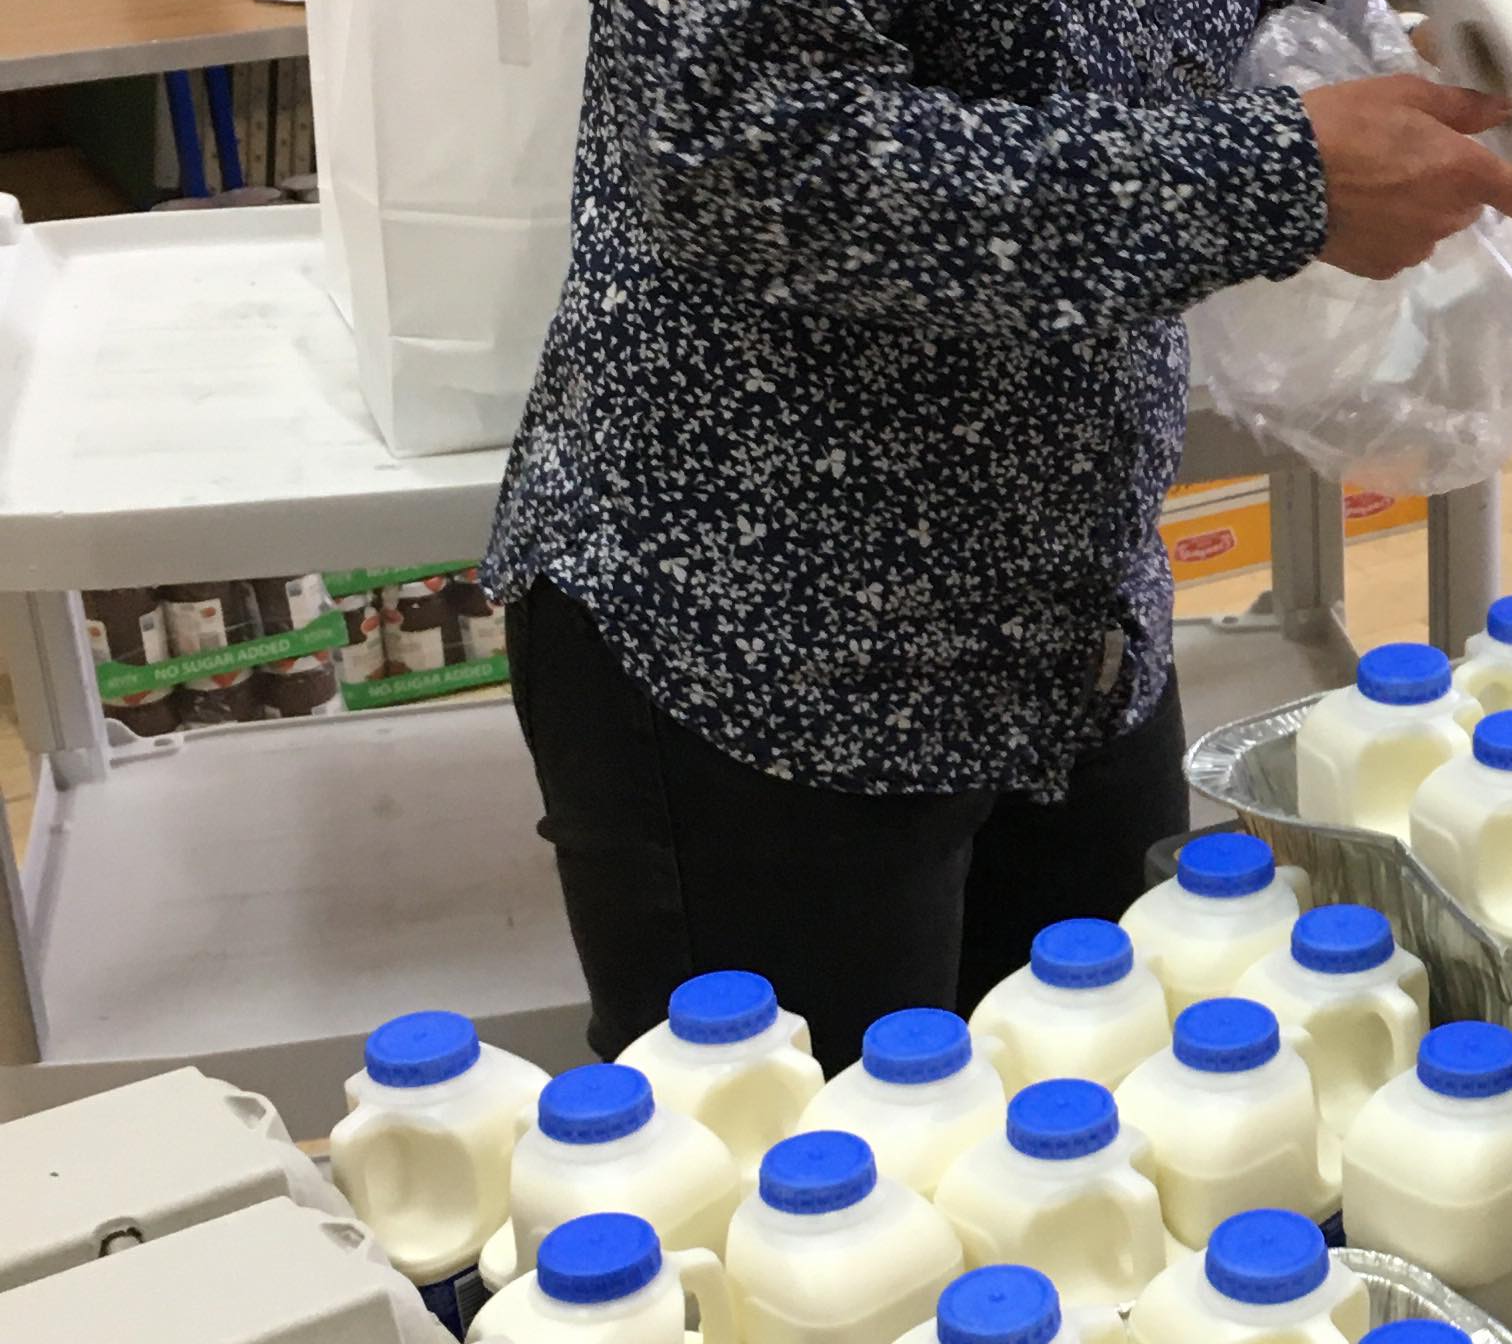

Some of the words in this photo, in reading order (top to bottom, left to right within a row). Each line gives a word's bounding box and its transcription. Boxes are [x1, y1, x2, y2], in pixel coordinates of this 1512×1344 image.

[154, 663, 178, 680] NO
[181, 651, 234, 676] SUGAR
[236, 637, 290, 665] ADDED
[368, 680, 389, 697] NO
[394, 671, 443, 693] SUGAR
[445, 661, 493, 686] ADDED
